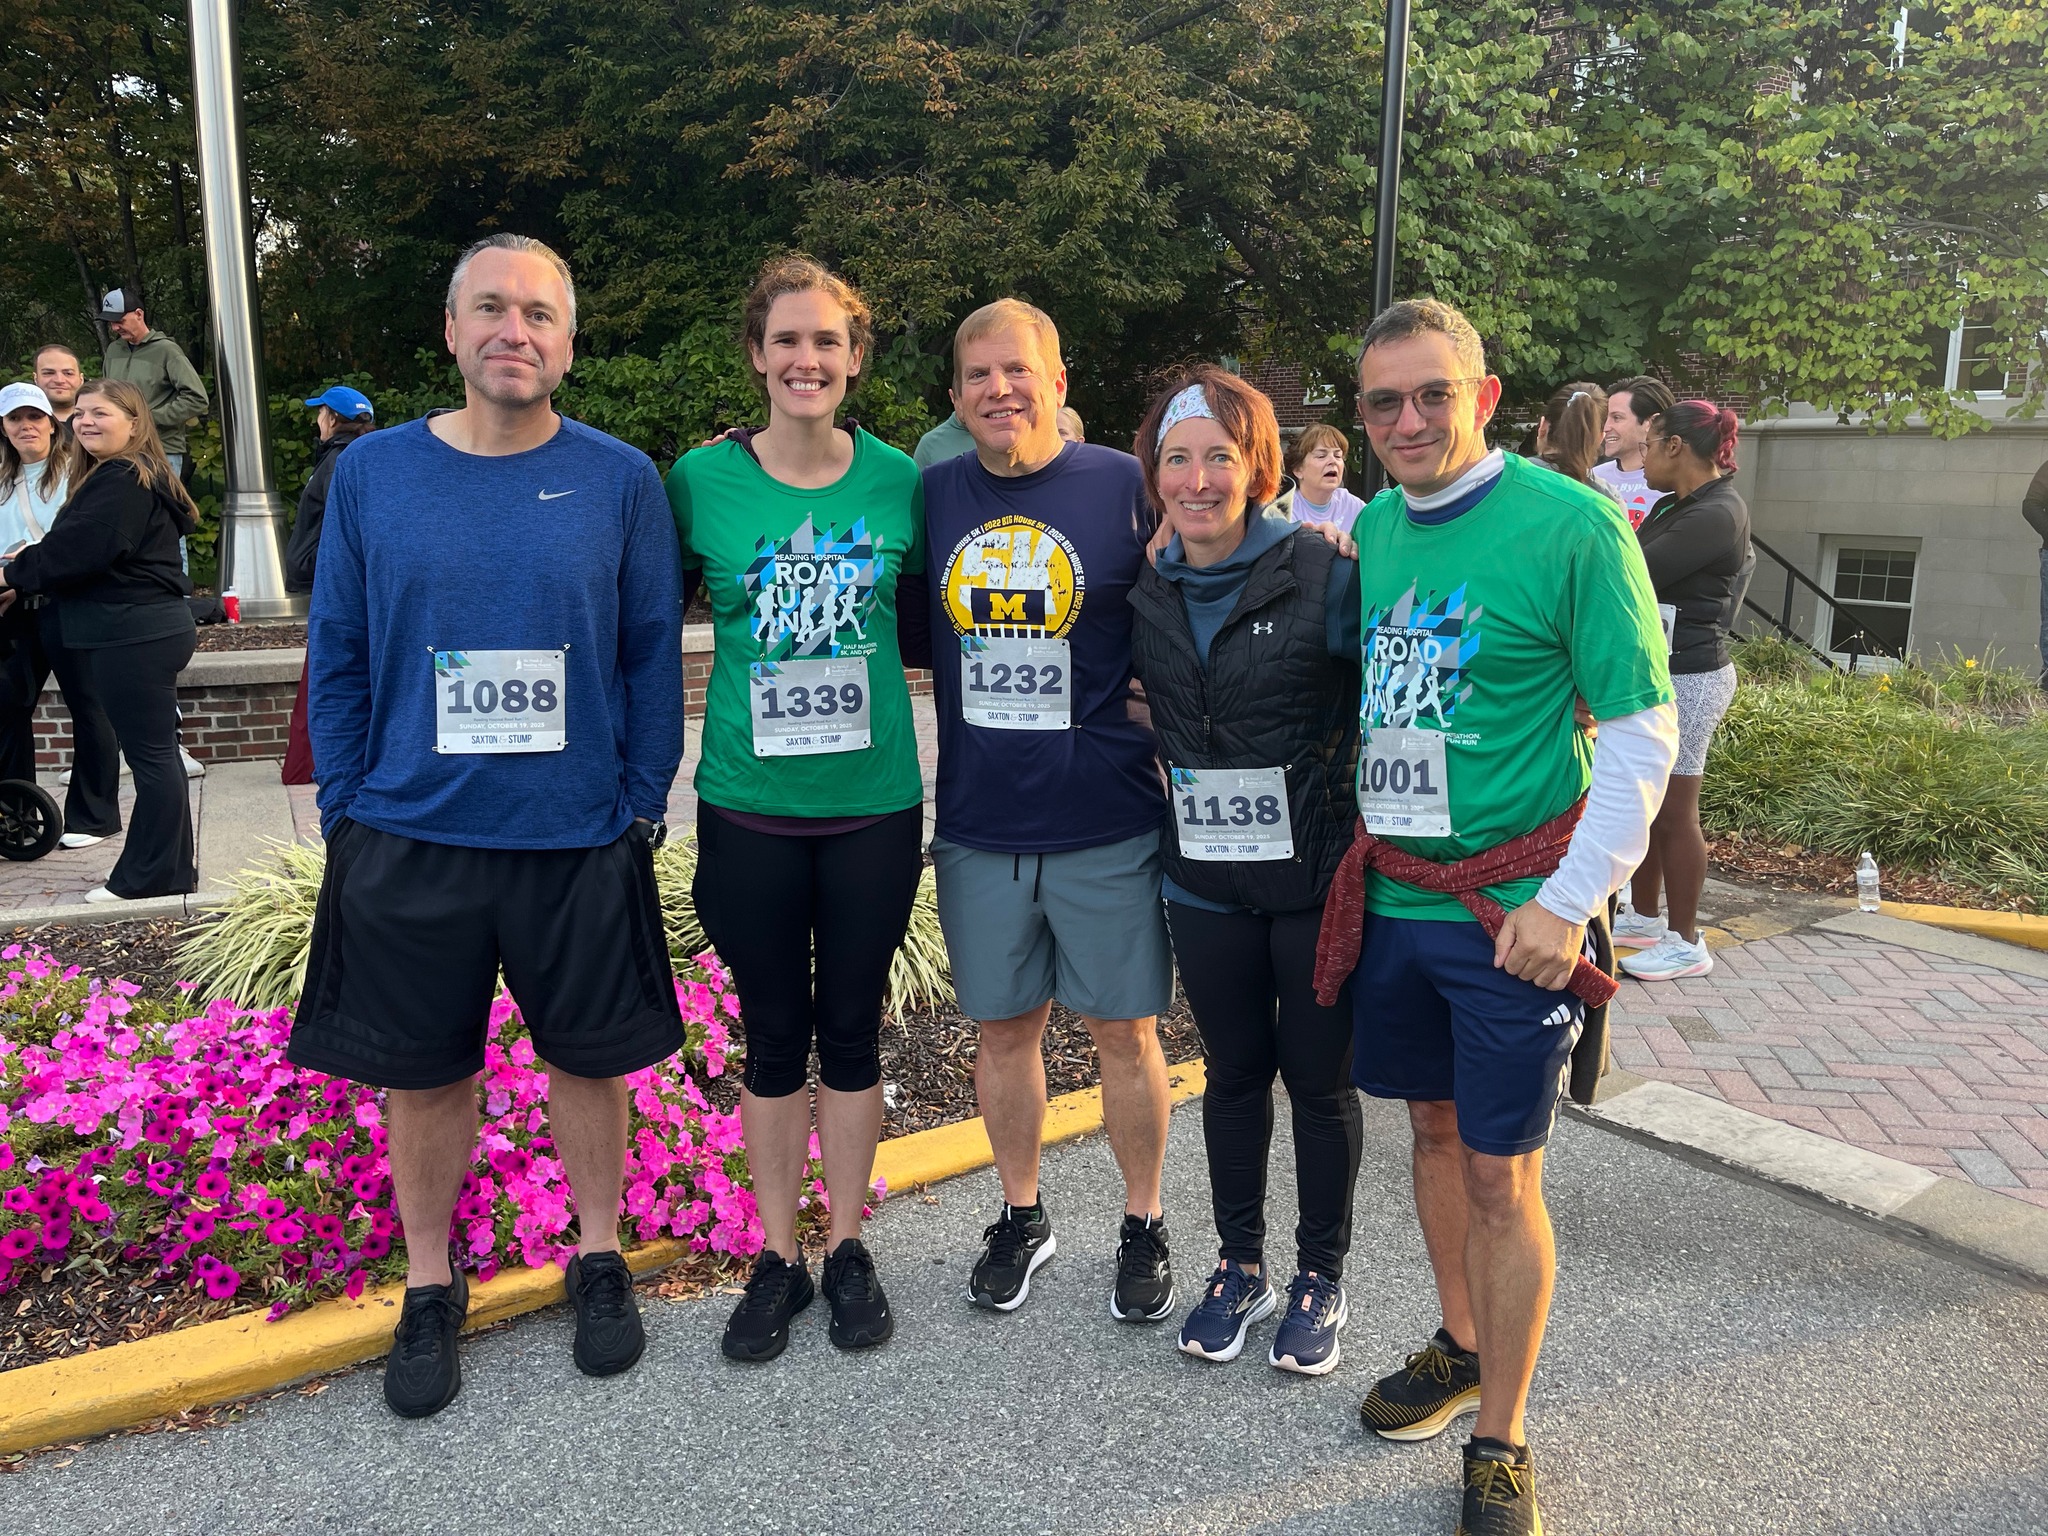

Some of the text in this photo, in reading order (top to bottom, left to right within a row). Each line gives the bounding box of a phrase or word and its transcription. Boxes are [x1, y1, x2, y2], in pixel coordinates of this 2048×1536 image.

[984, 515, 1047, 531] 2022 BIG HOUSE 5K
[946, 553, 957, 567] BIG
[953, 534, 972, 554] HOUSE
[970, 527, 981, 537] 5K
[1048, 528, 1085, 586] 2022 BIG HOUSE 5K
[775, 562, 859, 585] ROAD
[989, 593, 1026, 620] M
[1073, 591, 1084, 610] 2022
[1067, 609, 1080, 623] BIG
[1377, 626, 1433, 637] READING HOSPITAL
[1375, 635, 1442, 664] ROAD
[969, 662, 1062, 695] 1232
[447, 679, 558, 713] 1088
[761, 683, 863, 719] 1339
[988, 712, 1009, 720] SAXTON
[1018, 713, 1039, 721] STUMP
[472, 735, 497, 744] SAXTON
[508, 735, 532, 743] STUMP
[786, 737, 811, 746] SAXTON
[820, 735, 841, 744] STUMP
[1360, 758, 1438, 795] 1001
[1182, 795, 1281, 826] 1138
[1392, 816, 1412, 826] STUMP
[1205, 845, 1229, 853] SAXTON
[1238, 845, 1259, 853] STUMP
